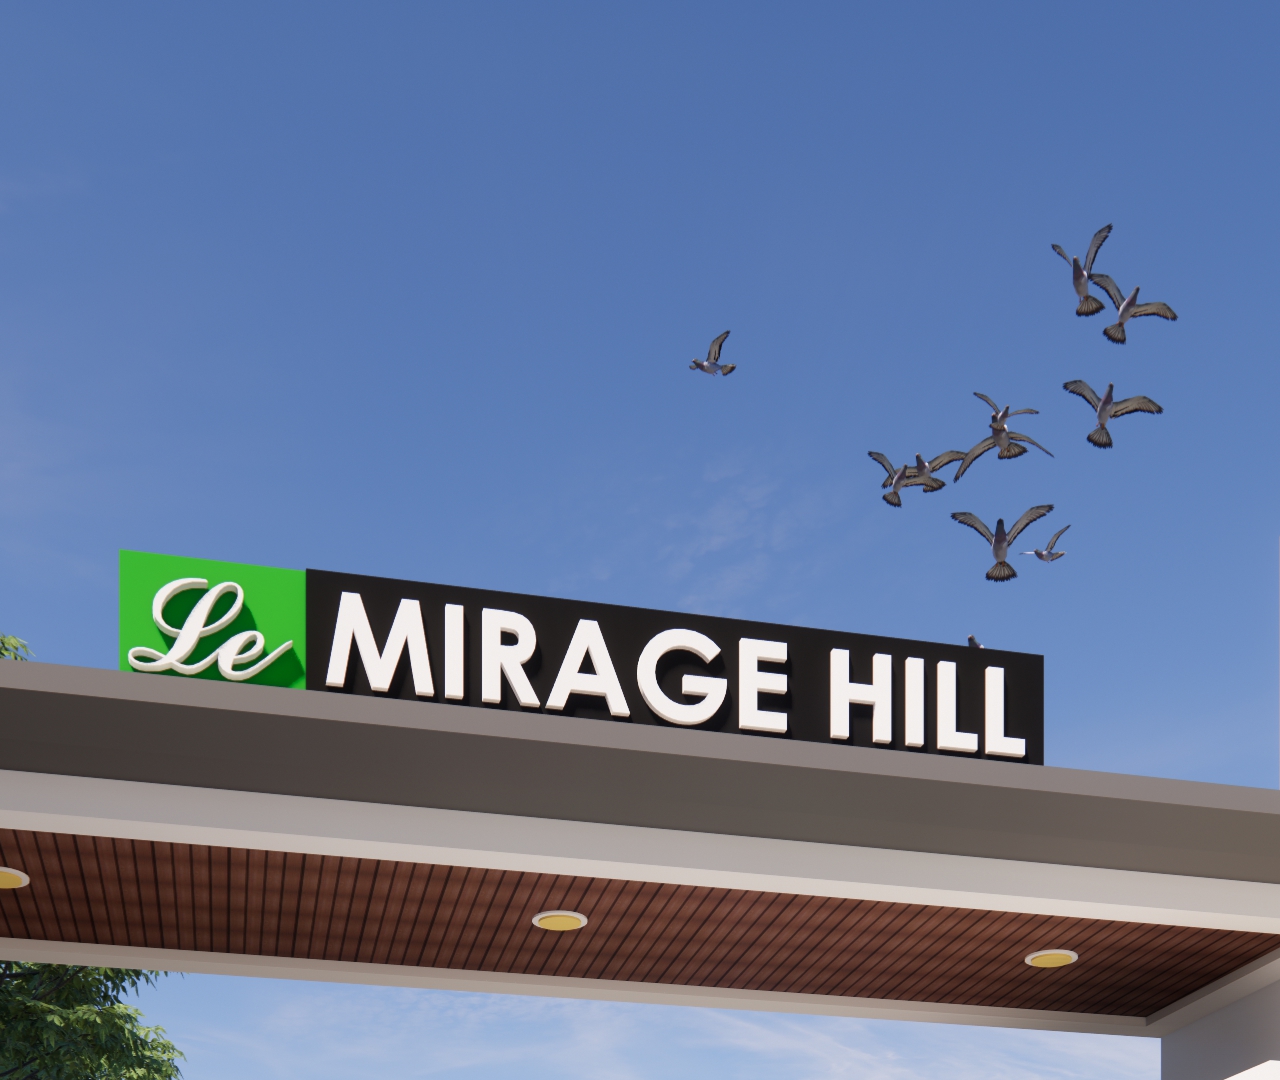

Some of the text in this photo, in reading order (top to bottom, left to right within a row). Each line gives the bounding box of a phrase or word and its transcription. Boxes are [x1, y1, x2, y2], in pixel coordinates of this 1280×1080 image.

[128, 577, 1026, 758] Le MIRAGE HILL
